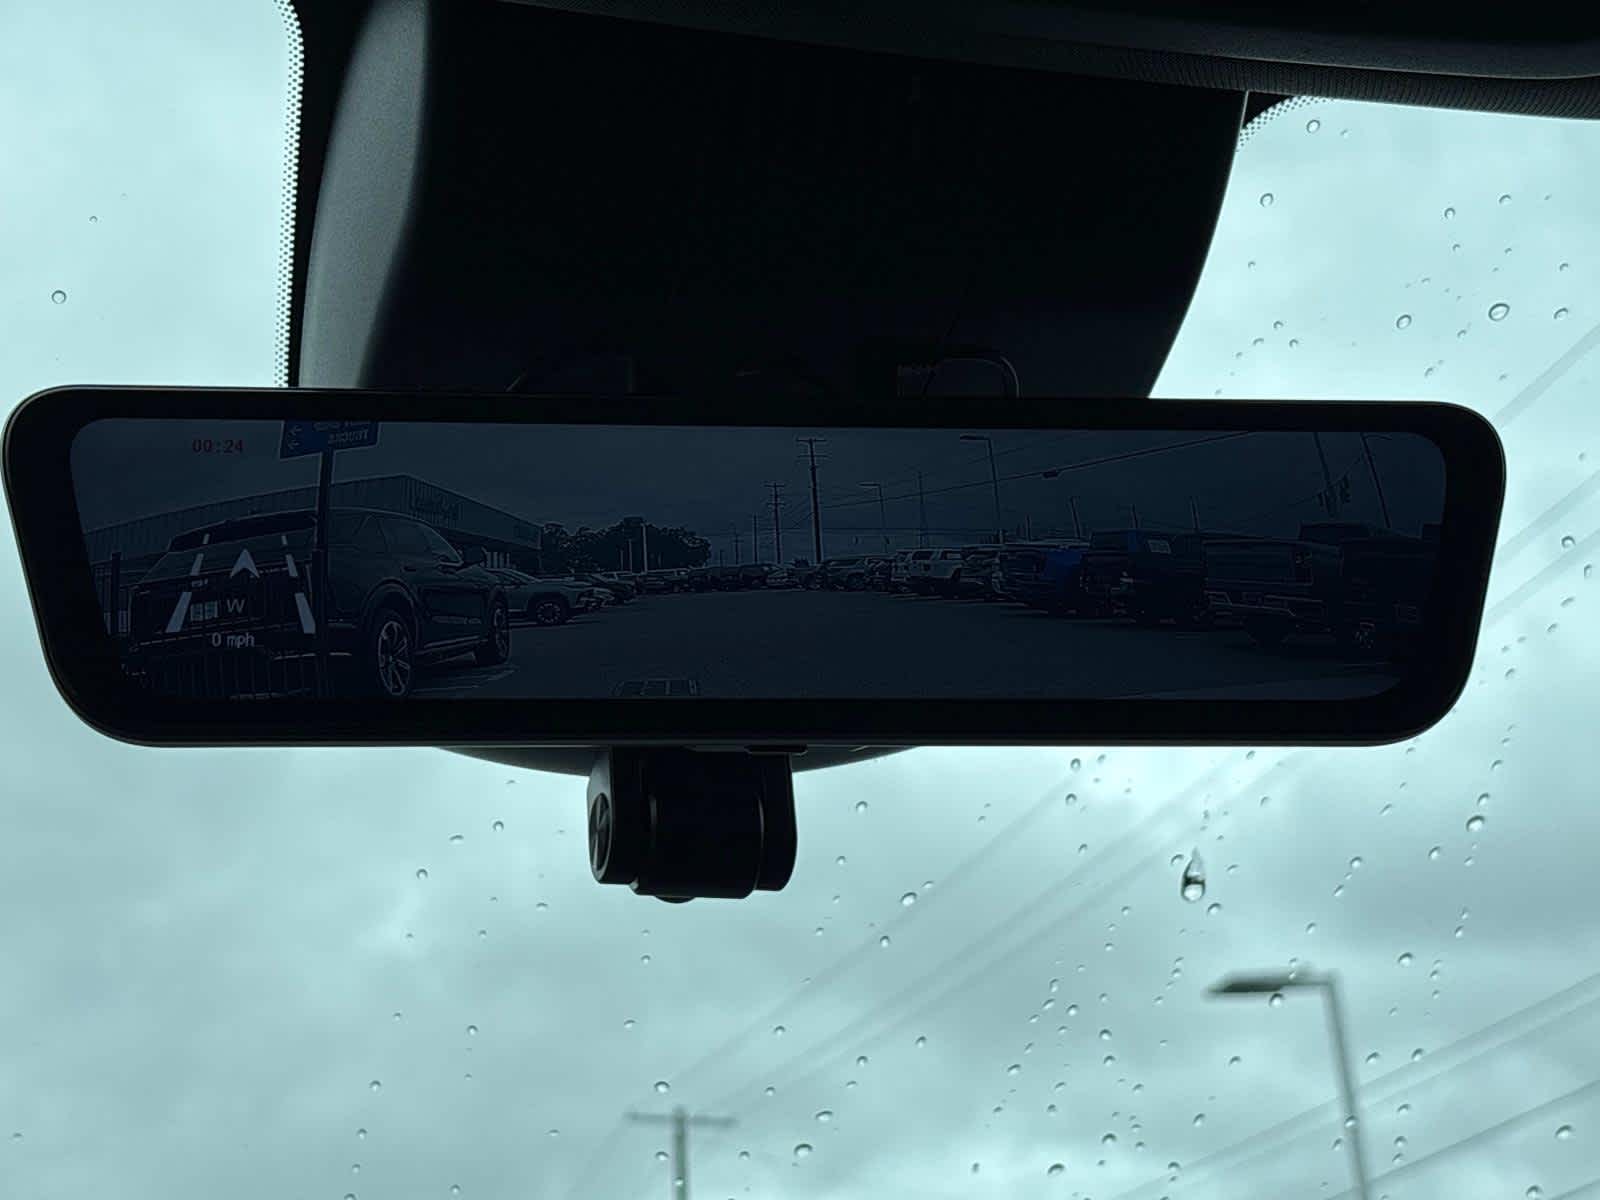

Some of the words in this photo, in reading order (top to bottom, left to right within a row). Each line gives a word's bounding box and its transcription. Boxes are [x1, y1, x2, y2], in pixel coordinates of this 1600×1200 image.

[192, 439, 243, 454] 00:24
[226, 598, 247, 613] W
[212, 632, 222, 648] 0
[226, 632, 255, 649] mph
